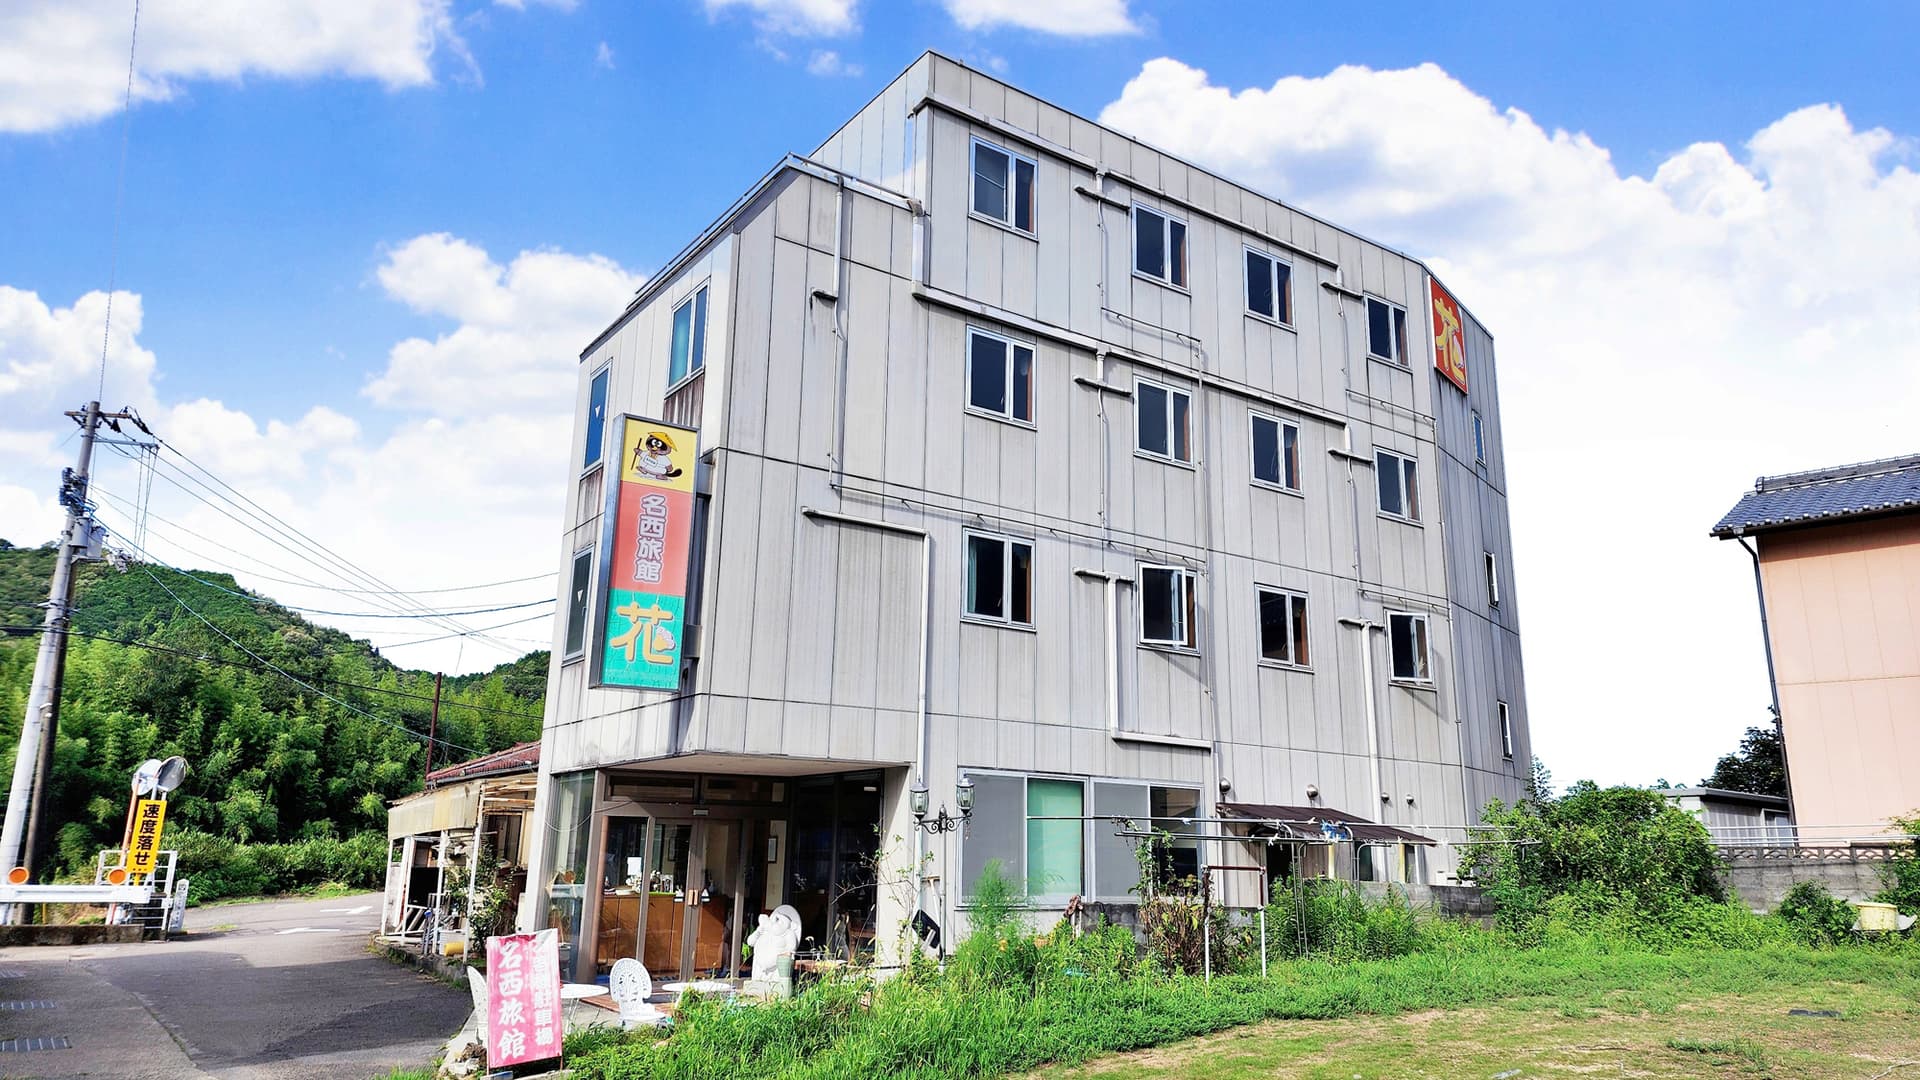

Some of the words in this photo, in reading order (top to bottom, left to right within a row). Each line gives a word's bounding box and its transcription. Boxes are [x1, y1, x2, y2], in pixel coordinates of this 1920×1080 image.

[1434, 298, 1465, 385] 花
[634, 493, 667, 584] 名西旅館
[609, 601, 674, 665] 花
[134, 804, 161, 866] 速度落せ
[498, 941, 526, 1060] 名西旅館
